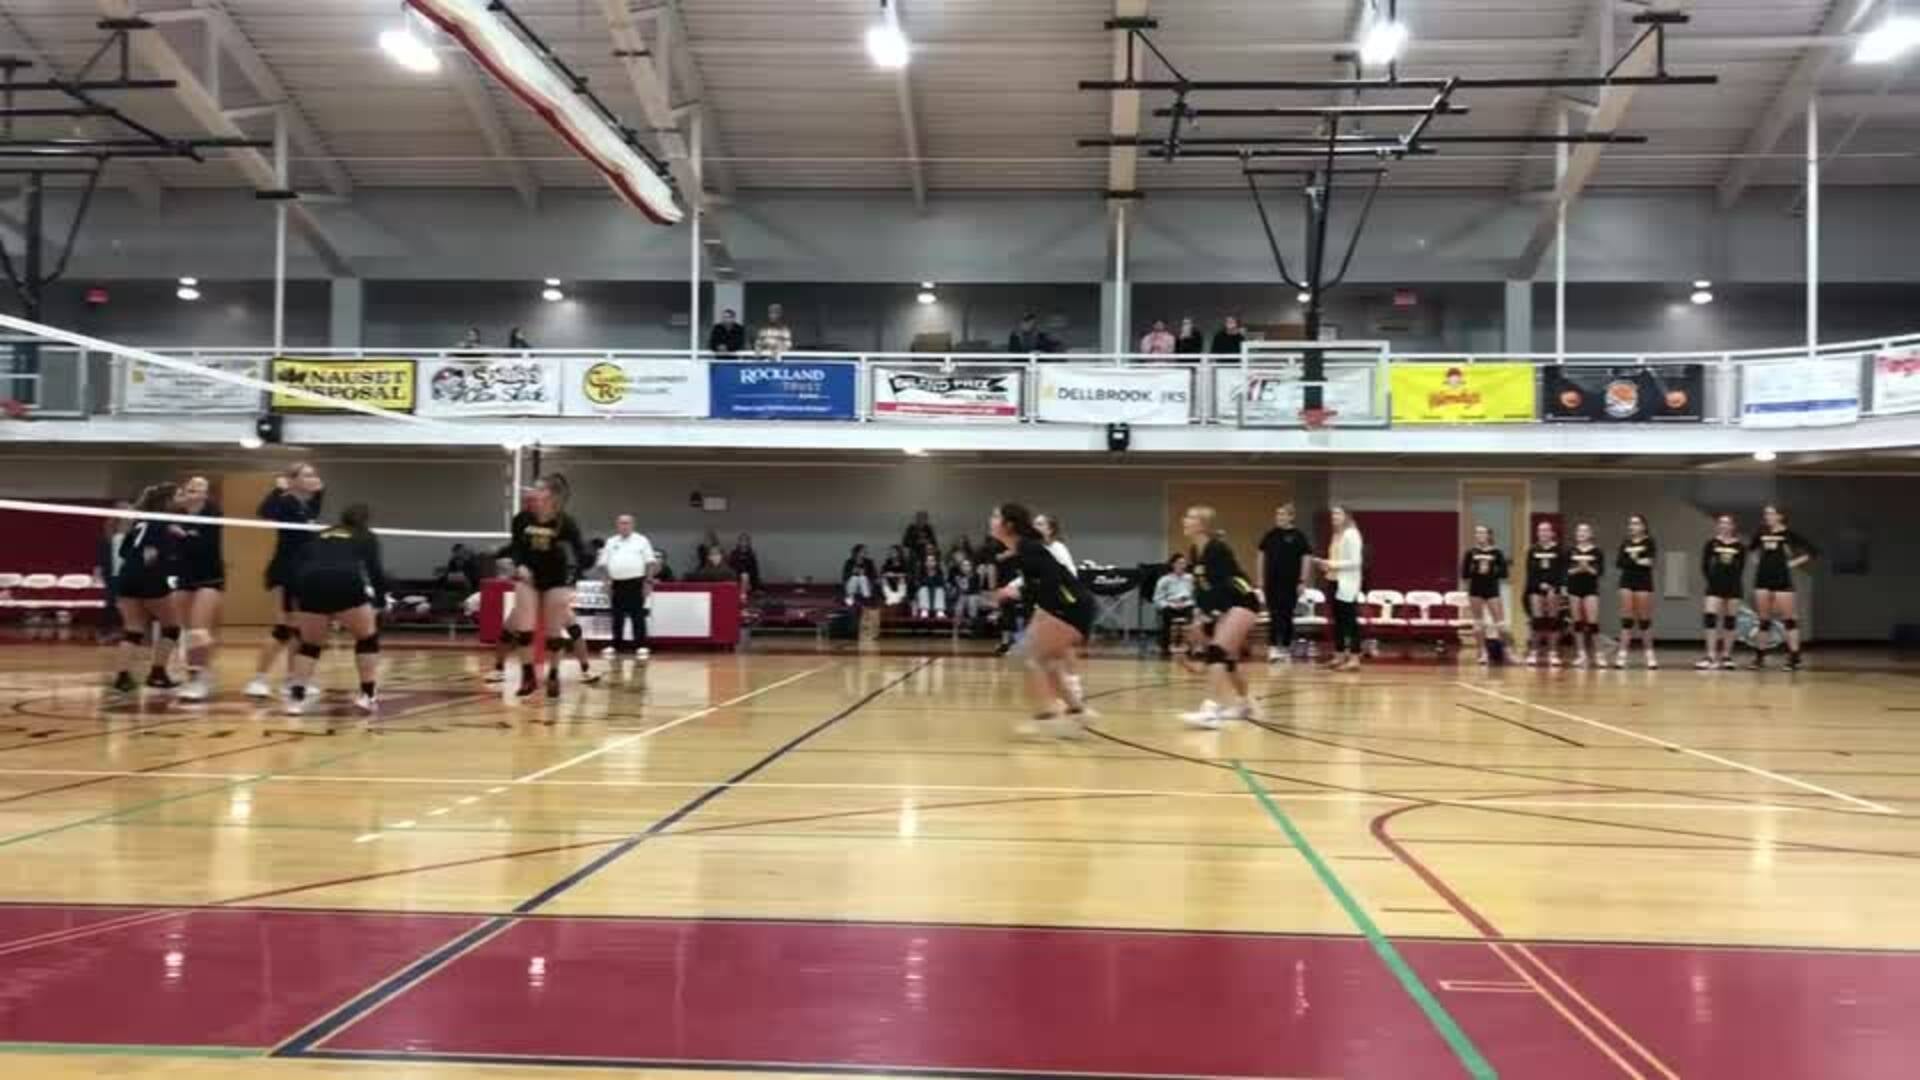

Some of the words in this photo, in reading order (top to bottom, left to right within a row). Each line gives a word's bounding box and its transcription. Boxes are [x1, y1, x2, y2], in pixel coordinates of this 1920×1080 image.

[311, 370, 407, 384] NAUSET
[740, 368, 826, 384] ROCKLAND
[1057, 387, 1153, 402] DELLBROOK
